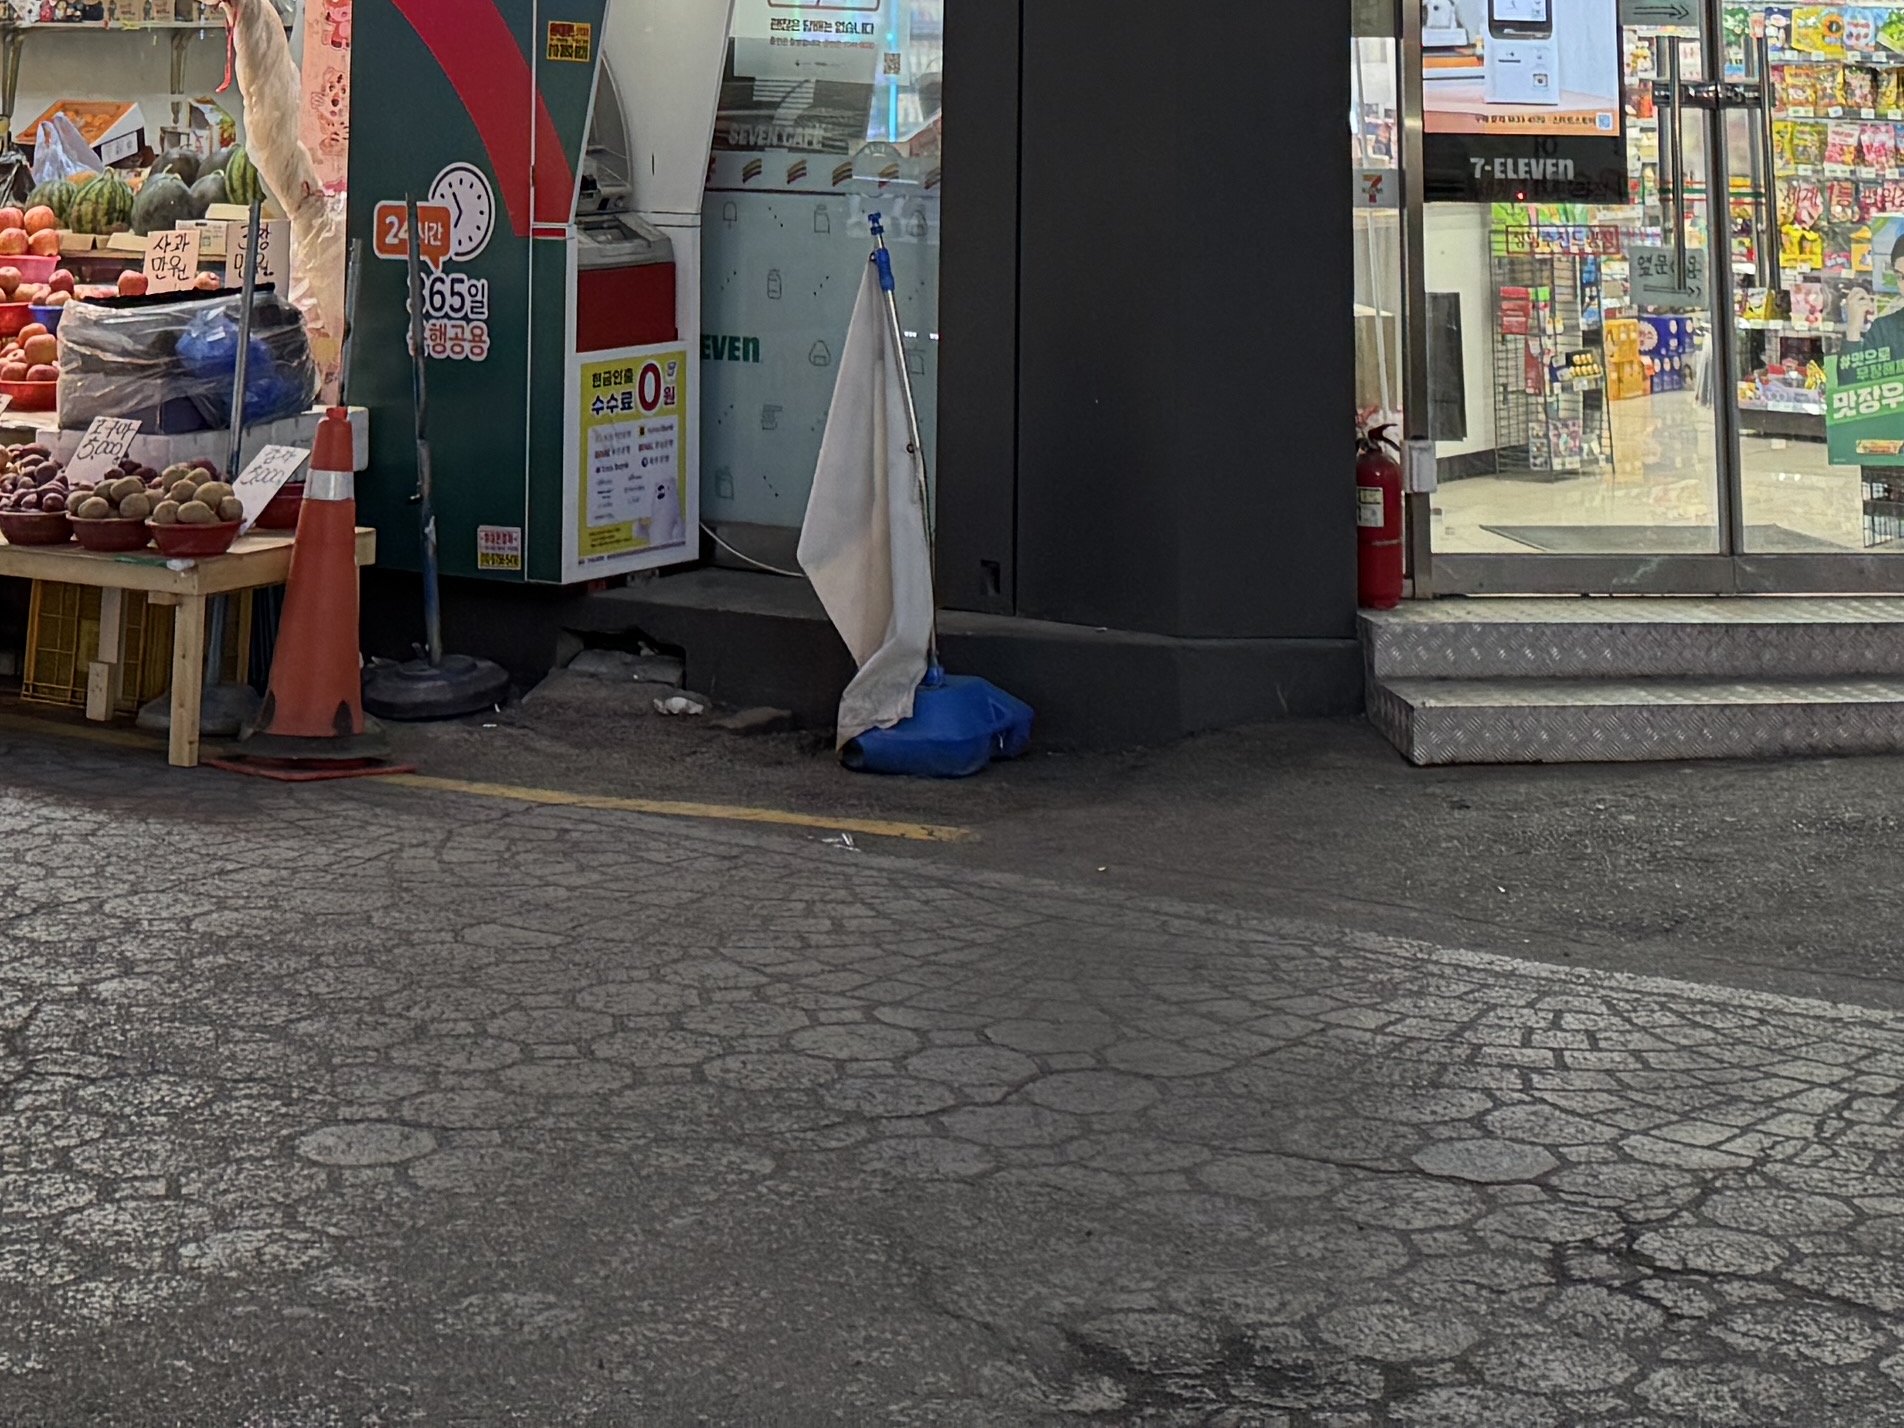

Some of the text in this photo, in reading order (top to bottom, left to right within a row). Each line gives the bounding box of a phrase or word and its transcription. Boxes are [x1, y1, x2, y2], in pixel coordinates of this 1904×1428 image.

[151, 232, 190, 253] 사과
[150, 254, 190, 281] 만원
[1636, 253, 1702, 280] 옆문용
[410, 274, 487, 316] 65일
[410, 321, 489, 358] 행공용
[591, 391, 634, 416] 수수료
[1832, 381, 1904, 420] 맛장우
[90, 419, 137, 439] 고구마
